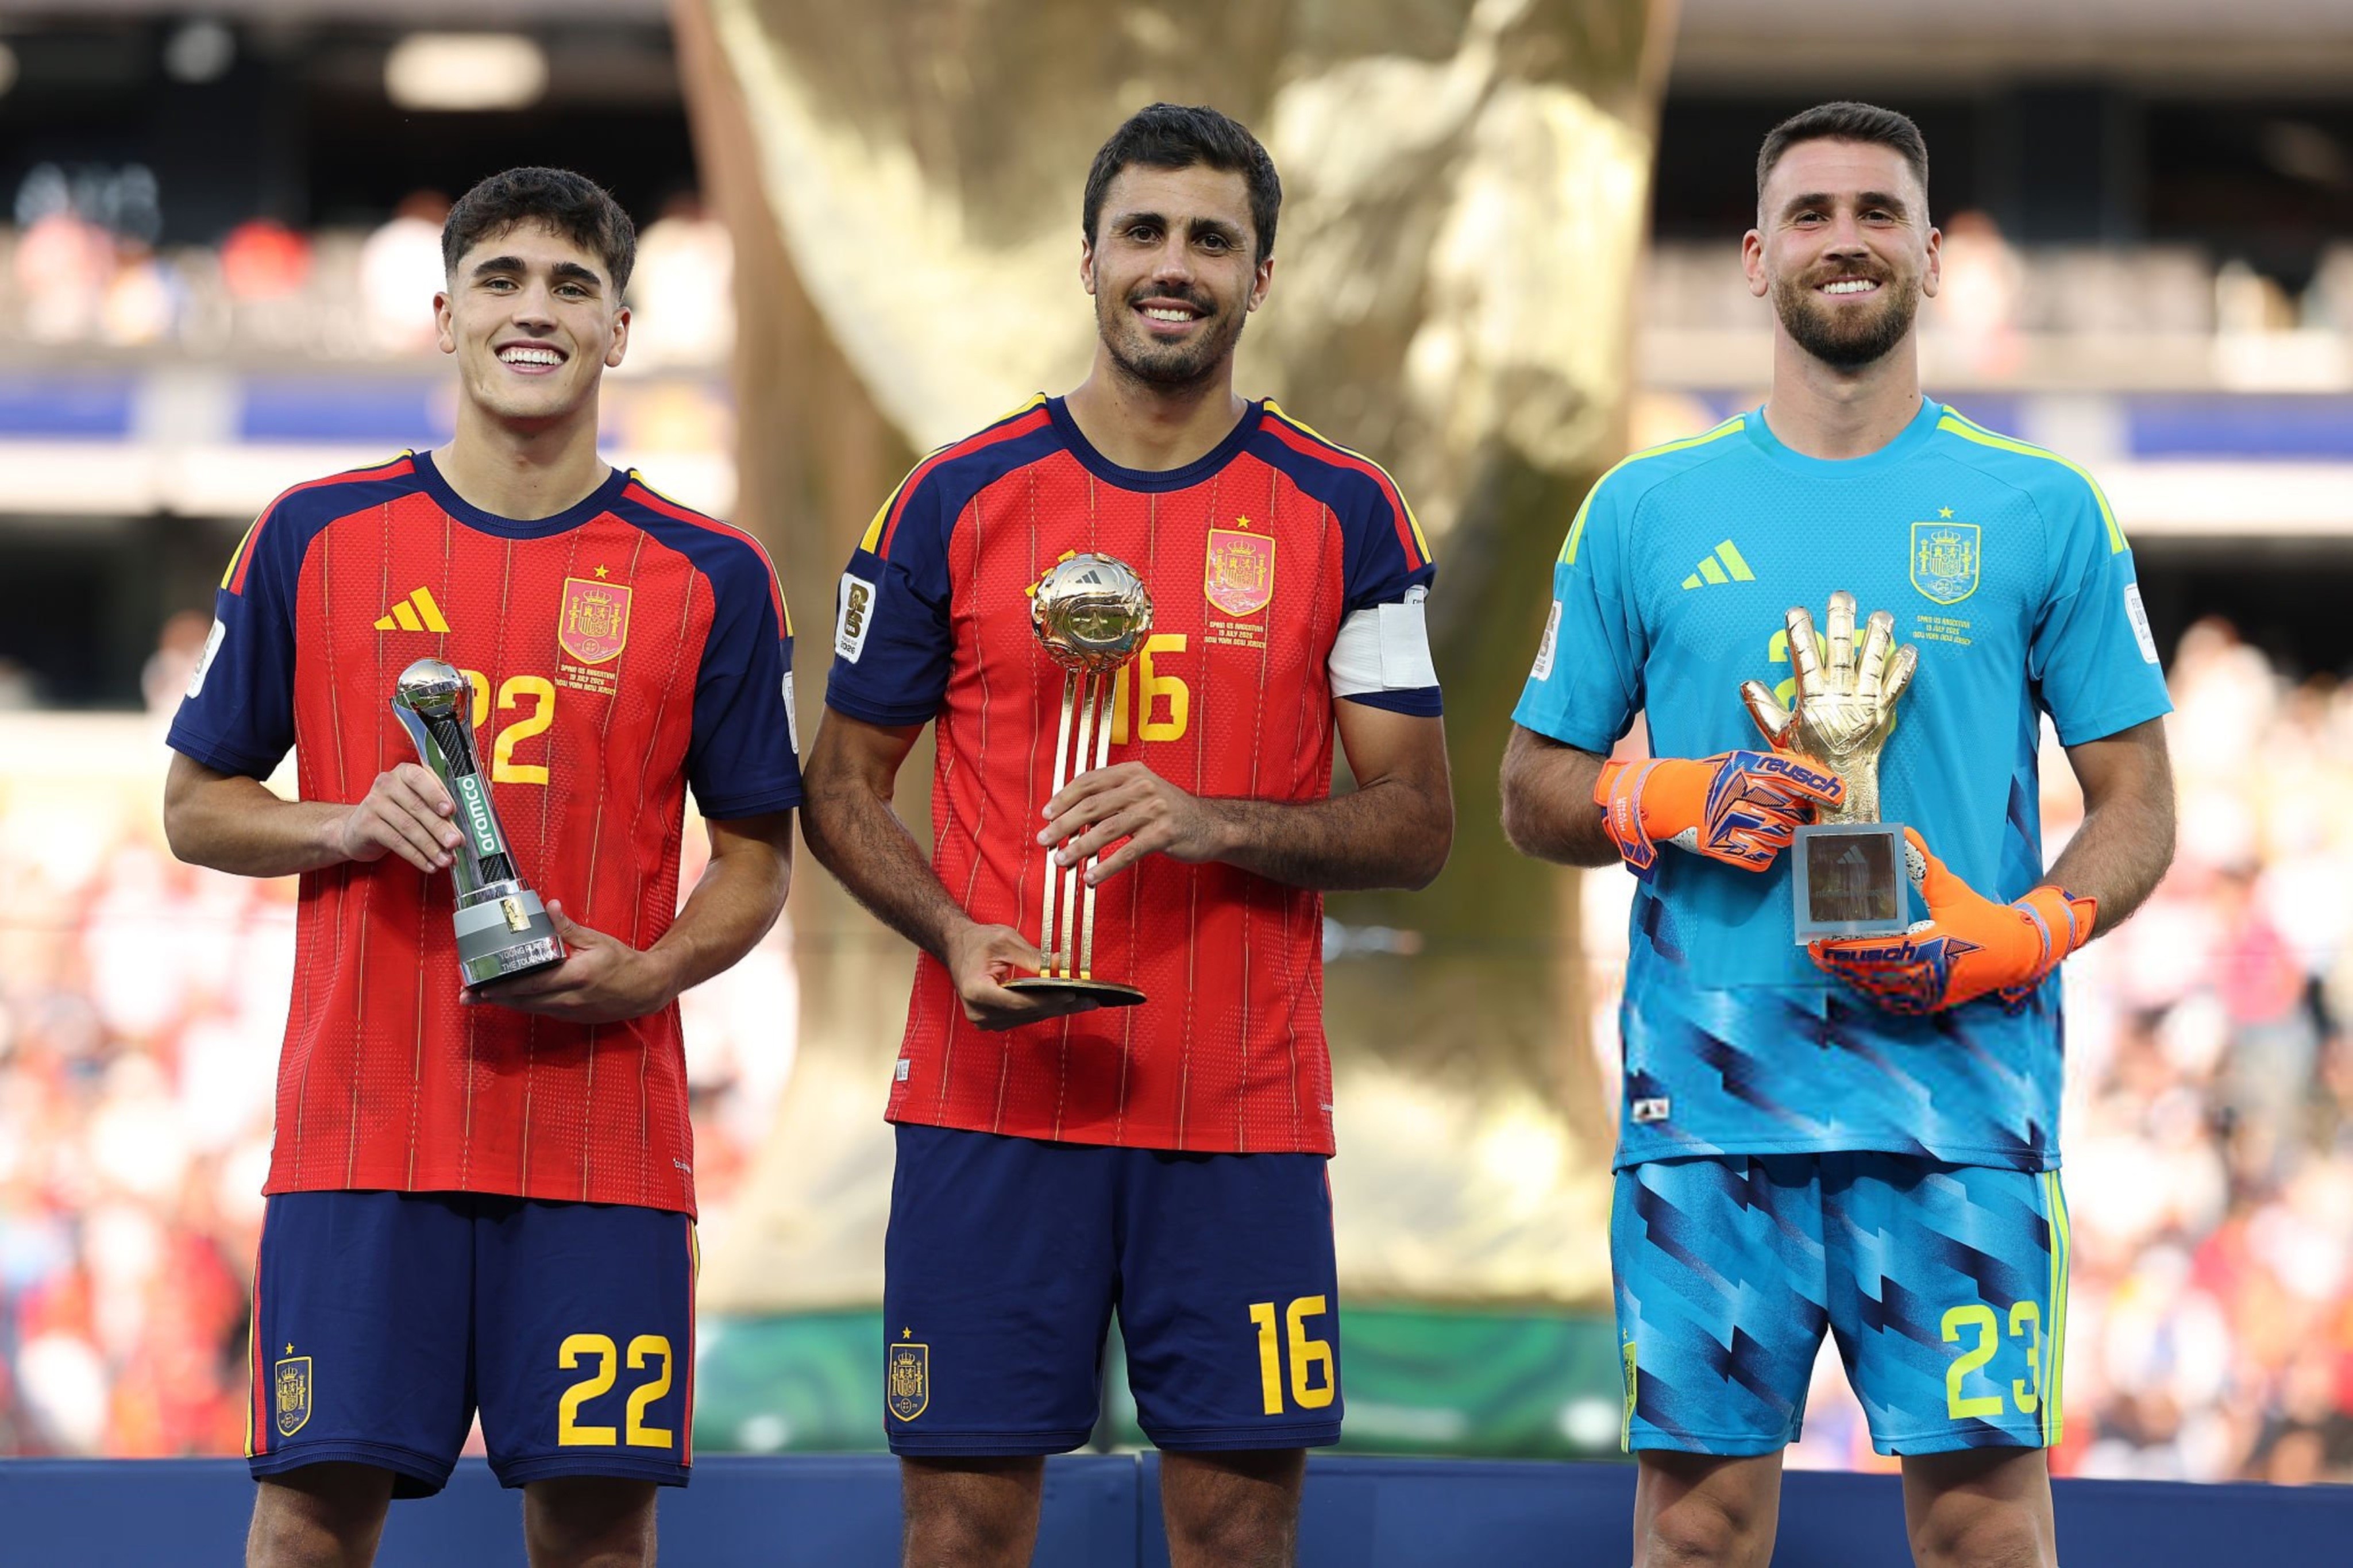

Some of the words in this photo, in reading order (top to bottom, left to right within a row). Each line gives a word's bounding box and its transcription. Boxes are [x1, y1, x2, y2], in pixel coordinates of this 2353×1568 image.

[461, 669, 556, 785] 2
[1757, 757, 1841, 797] reusch
[462, 778, 495, 852] aramco
[499, 947, 524, 960] YOUNG
[502, 961, 516, 971] THE
[1823, 941, 1916, 961] reusch
[558, 1334, 672, 1449] 22
[1249, 1295, 1334, 1415] 16
[1941, 1300, 2039, 1420] 23
